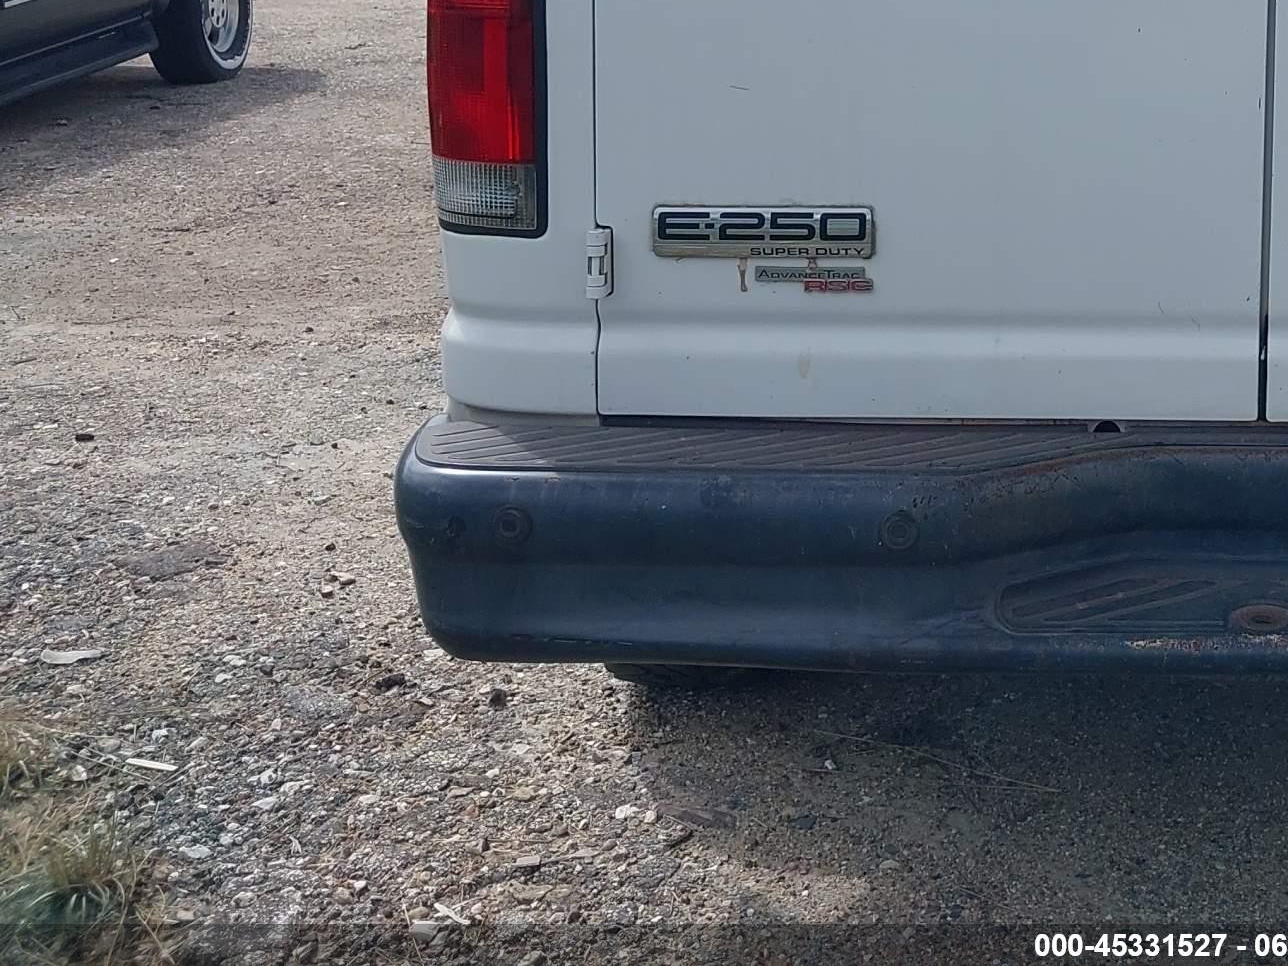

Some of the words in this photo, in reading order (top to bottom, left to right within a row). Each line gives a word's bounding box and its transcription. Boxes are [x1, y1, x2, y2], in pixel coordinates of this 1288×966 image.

[657, 211, 867, 241] E-250
[750, 247, 809, 256] SUPER
[815, 247, 865, 256] DUTY
[804, 280, 873, 292] RSC
